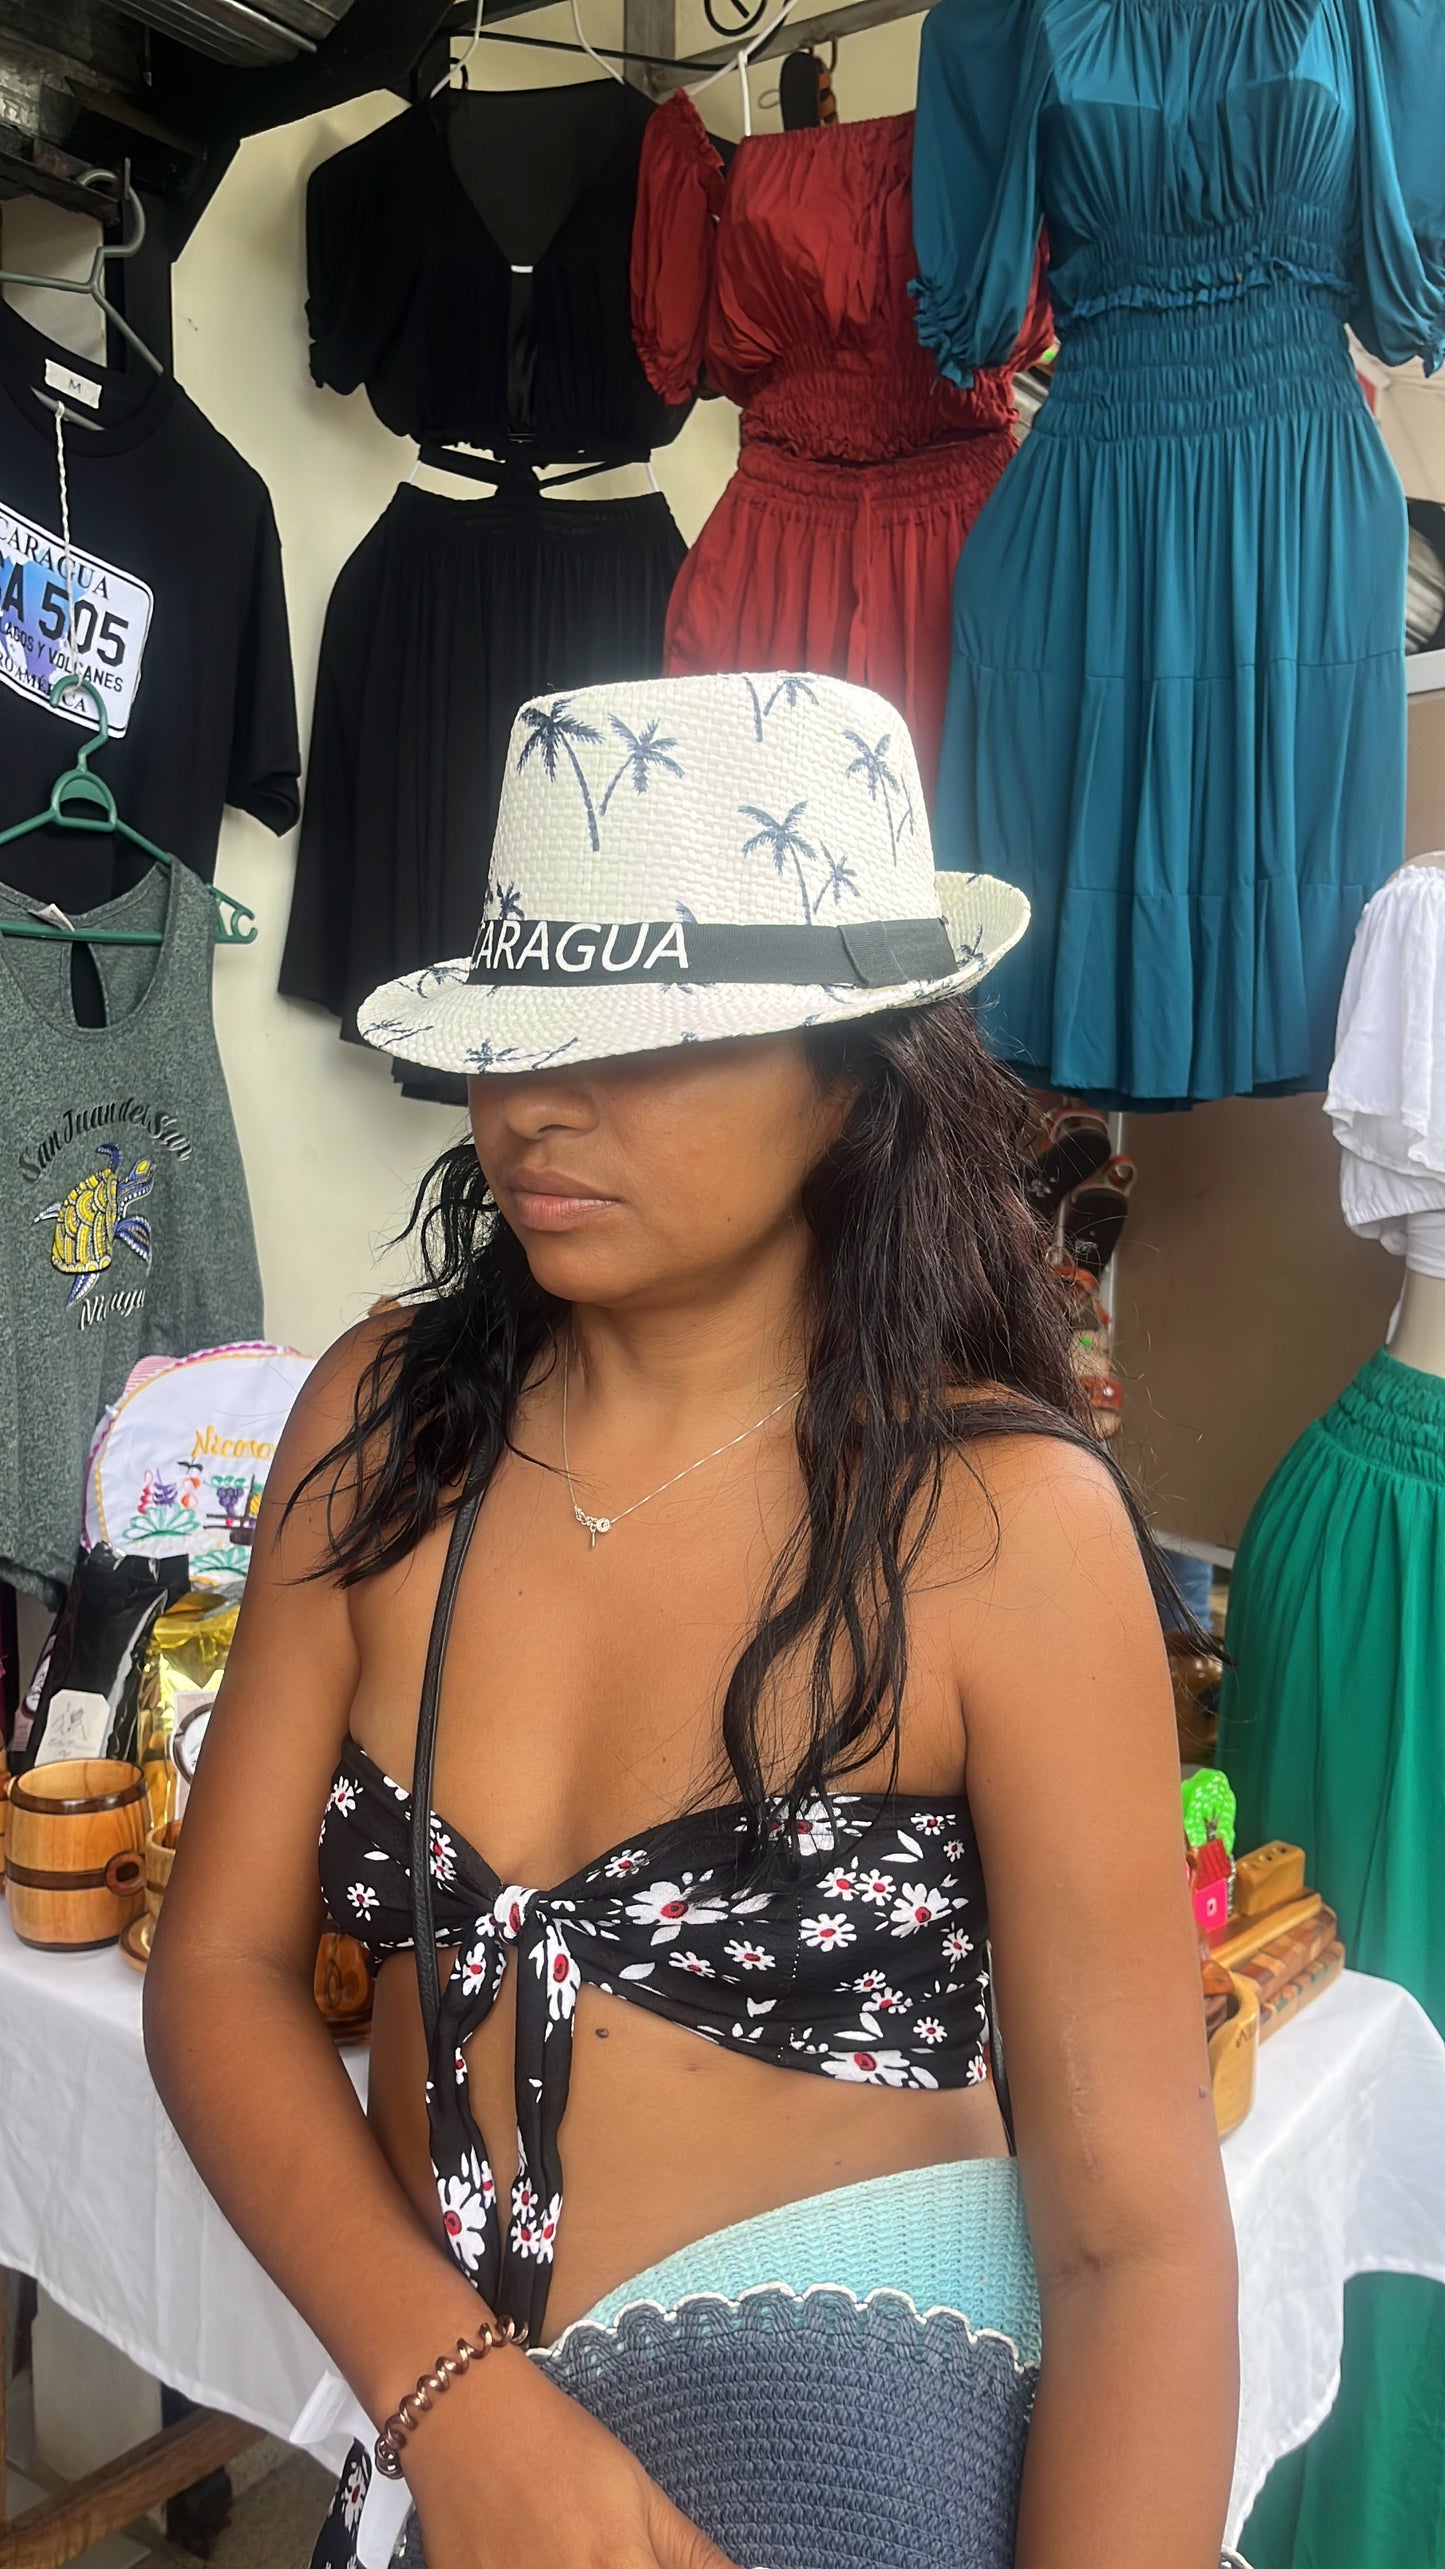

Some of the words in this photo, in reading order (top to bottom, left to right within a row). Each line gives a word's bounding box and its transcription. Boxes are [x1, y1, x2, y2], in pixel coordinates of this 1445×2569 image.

[69, 378, 82, 394] M
[39, 580, 129, 668] 505
[36, 641, 46, 658] Y
[48, 646, 124, 693] VOLCANES
[19, 1128, 63, 1184] San
[62, 1102, 116, 1145] Juan
